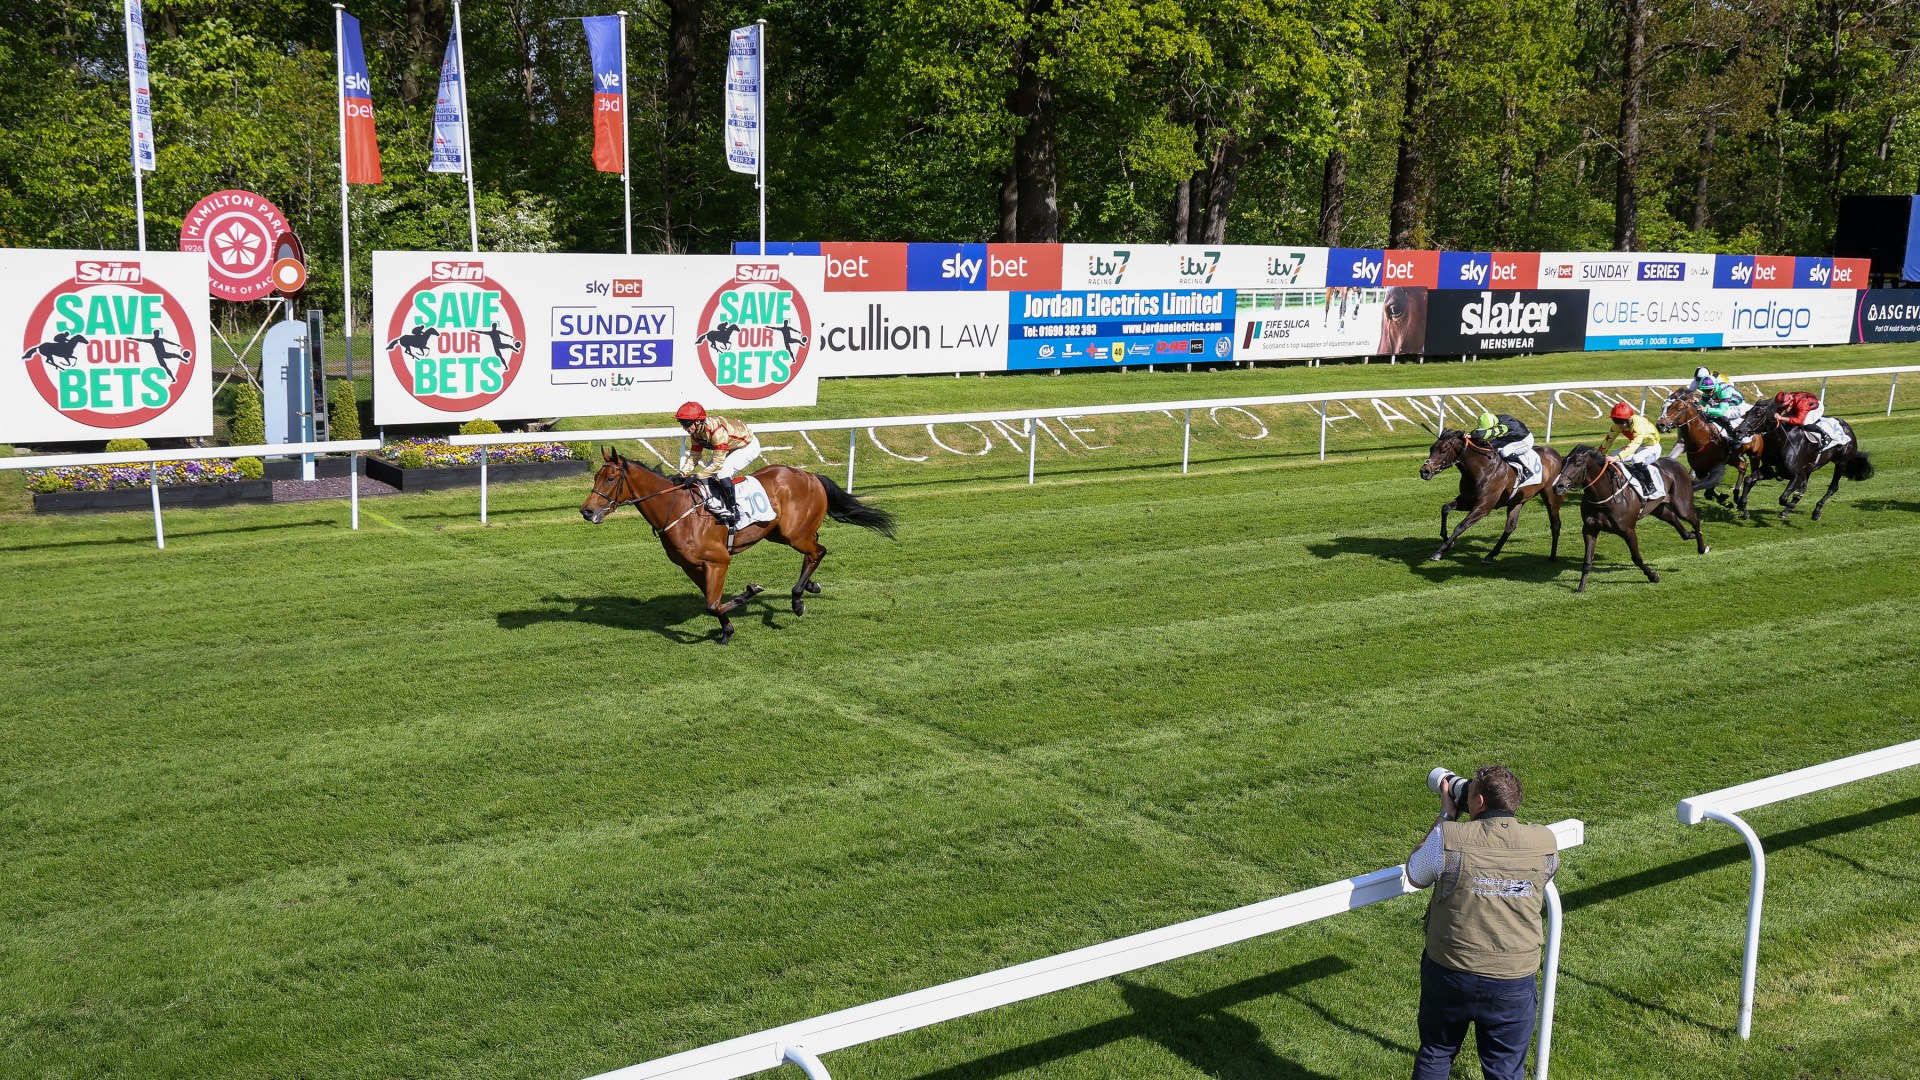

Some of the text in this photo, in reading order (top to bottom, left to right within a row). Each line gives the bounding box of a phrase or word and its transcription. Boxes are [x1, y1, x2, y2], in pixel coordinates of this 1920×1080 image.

[345, 72, 370, 95] sky
[346, 101, 374, 118] bet
[187, 194, 284, 238] HAMILTON PARK
[77, 262, 140, 281] Sun
[433, 263, 483, 280] Sun
[737, 265, 779, 281] Sun
[827, 254, 869, 278] bet
[941, 253, 1028, 284] sky bet
[1352, 257, 1414, 284] sky bet
[1460, 259, 1517, 285] sky bet
[1544, 266, 1557, 278] sky
[1559, 265, 1572, 276] bet
[1582, 264, 1629, 279] SUNDAY
[1643, 264, 1680, 279] SERIES
[1731, 261, 1776, 285] sky bet
[1809, 263, 1853, 286] sky bet
[240, 286, 254, 294] OF
[586, 280, 640, 296] sky bet
[56, 294, 163, 335] SAVE
[414, 292, 500, 328] SAVE
[719, 291, 792, 326] SAVE
[1023, 291, 1223, 318] Jordan Electrics Limited
[1460, 292, 1557, 335] slater
[1878, 304, 1904, 320] ASG
[560, 314, 667, 336] SUNDAY
[1122, 322, 1223, 335] www.jordanelectrics.com
[1265, 319, 1310, 329] FIFE SILICA
[1732, 301, 1811, 338] indigo
[1899, 325, 1916, 333] Security
[738, 327, 774, 348] OUR
[940, 324, 1000, 349] LAW
[1023, 324, 1097, 338] Tel: 01698 382 393
[1263, 329, 1290, 339] SANDS
[1619, 336, 1695, 346] WINDOWS DOORS SCREENS
[87, 340, 140, 363] OUR
[437, 332, 480, 354] OUR
[1290, 342, 1300, 350] top
[1300, 341, 1322, 349] supplier
[1328, 339, 1355, 348] equestrian
[1480, 338, 1534, 350] MENSWEAR
[568, 343, 658, 366] SERIES
[415, 356, 501, 395] BETS
[717, 350, 790, 385] BETS
[59, 367, 169, 409] BETS
[590, 373, 635, 388] ON itv
[1533, 457, 1541, 474] 6
[744, 491, 769, 516] 10
